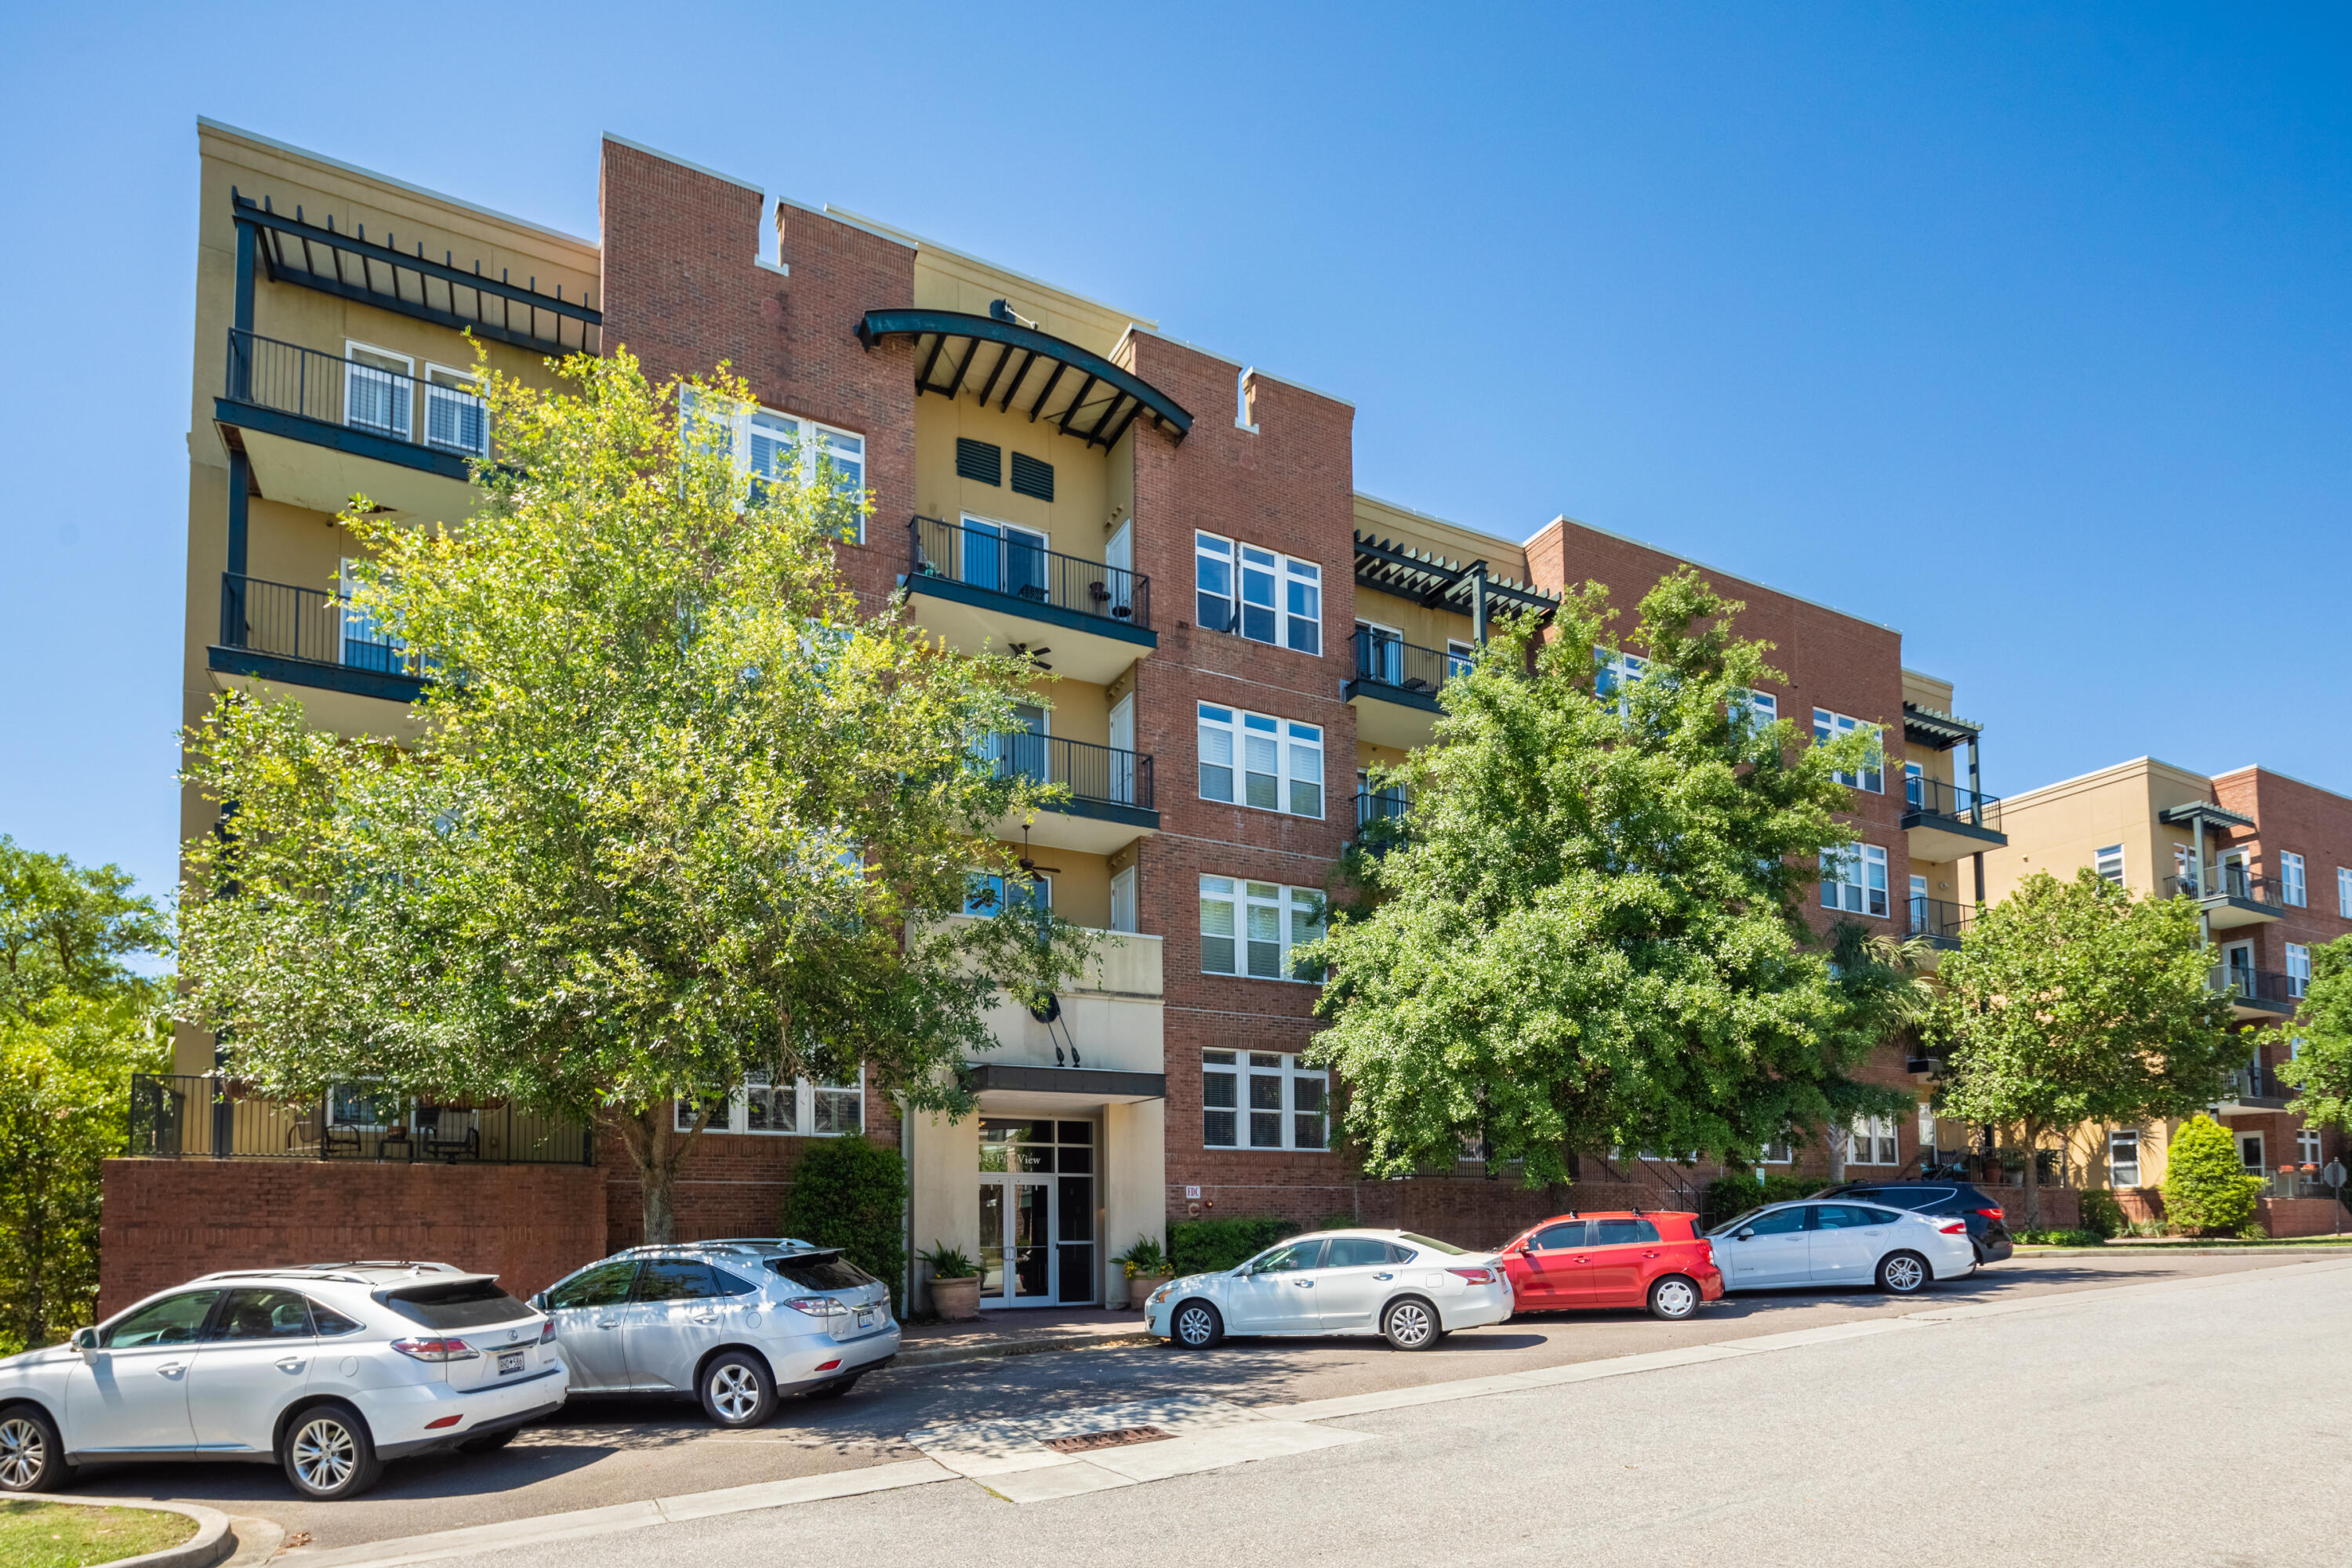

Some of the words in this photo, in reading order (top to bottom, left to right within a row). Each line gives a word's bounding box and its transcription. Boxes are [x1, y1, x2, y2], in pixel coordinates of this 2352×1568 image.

[978, 1153, 994, 1163] 145
[1018, 1154, 1041, 1164] View
[1188, 1187, 1198, 1196] FDC
